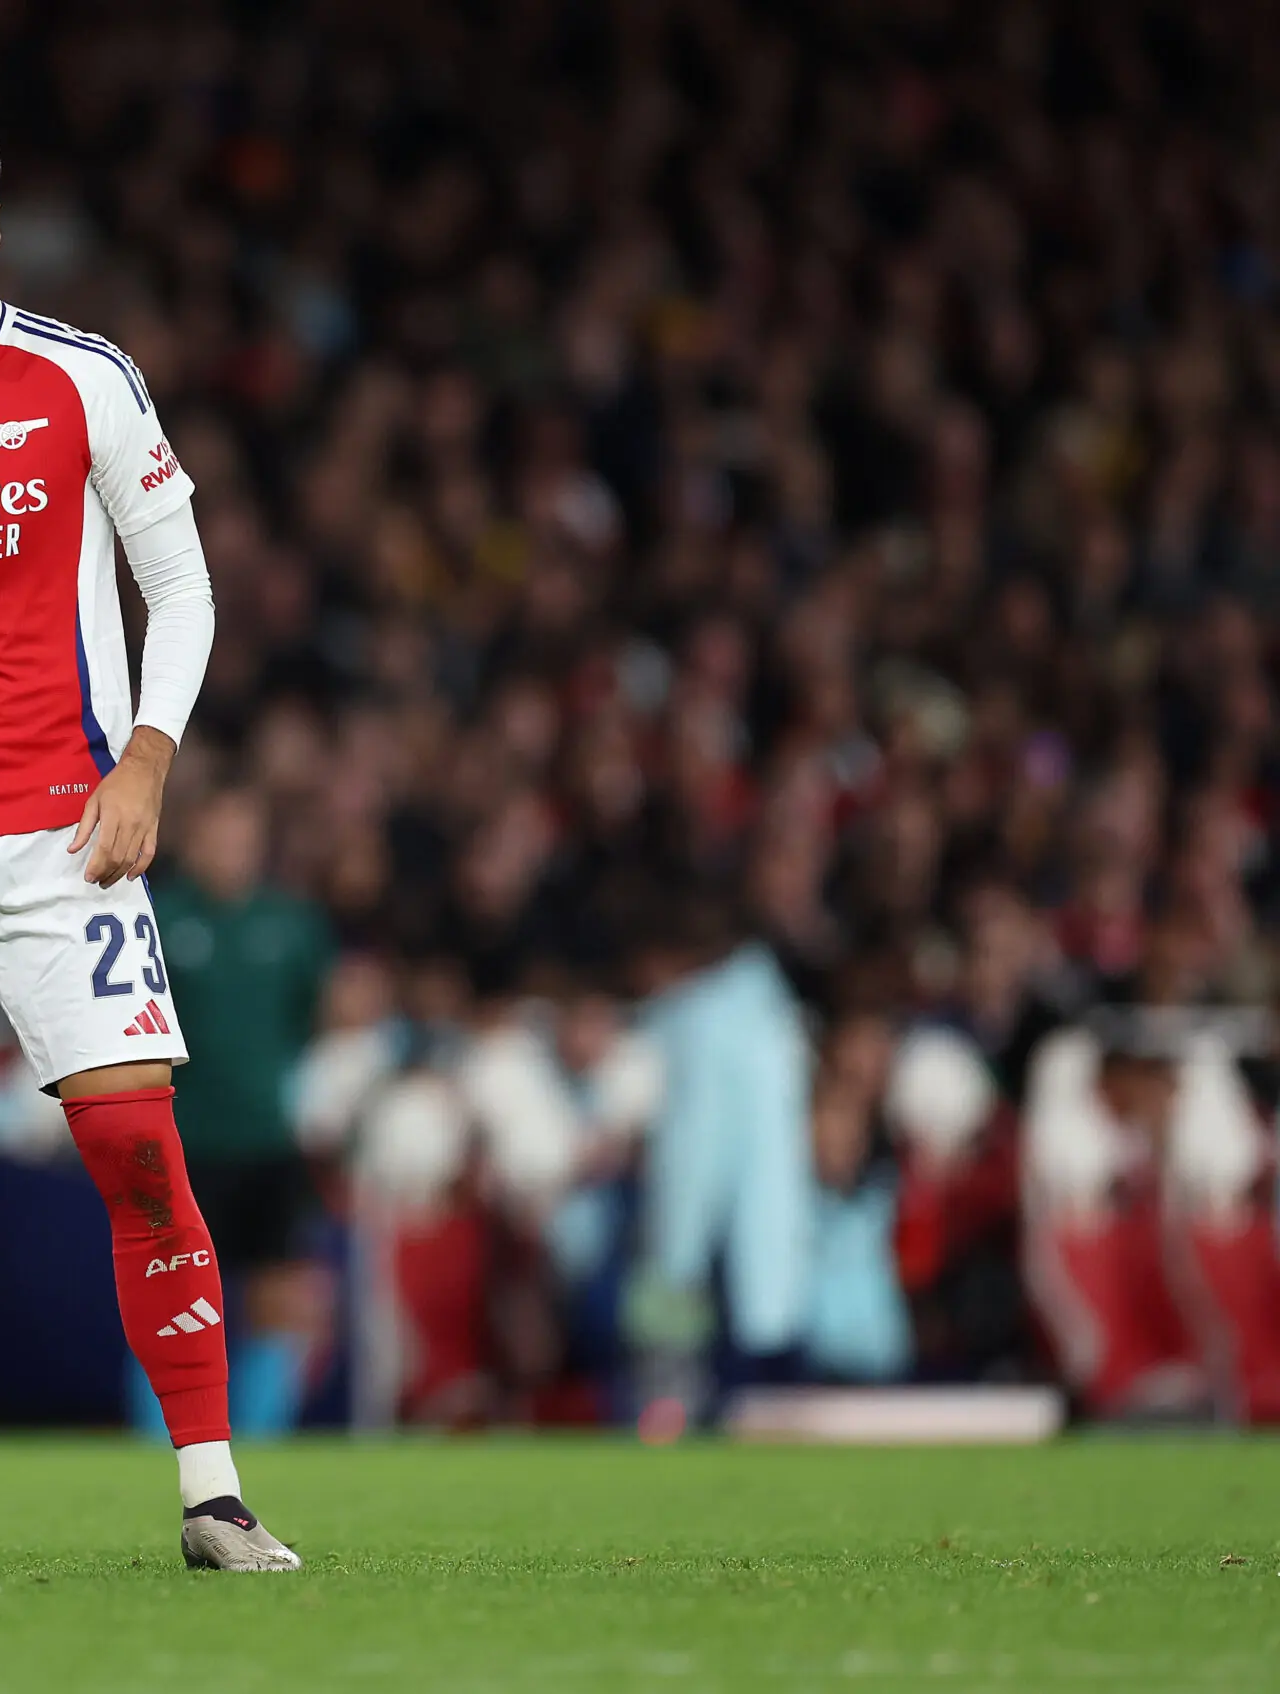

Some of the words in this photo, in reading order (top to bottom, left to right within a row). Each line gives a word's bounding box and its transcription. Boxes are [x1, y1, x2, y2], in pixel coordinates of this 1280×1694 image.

[49, 783, 89, 796] HEAT.RDY
[83, 912, 167, 999] 23
[145, 1249, 210, 1278] AFC
